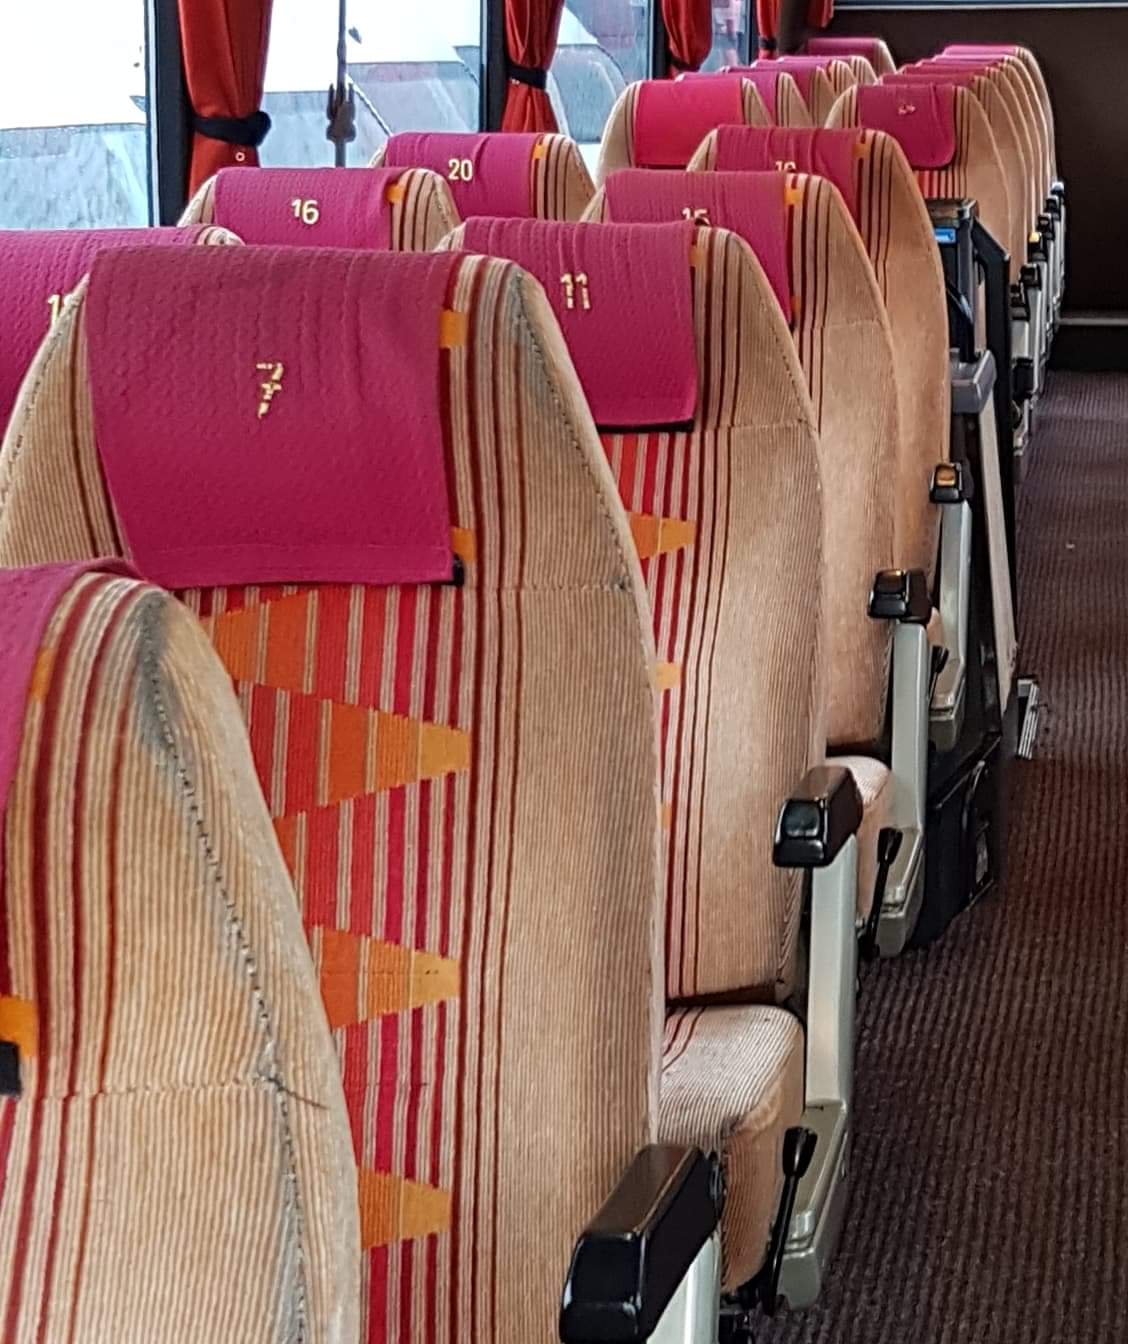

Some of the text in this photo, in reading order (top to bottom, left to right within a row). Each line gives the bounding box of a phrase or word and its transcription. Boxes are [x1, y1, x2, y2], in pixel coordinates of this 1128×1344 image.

[448, 159, 473, 182] 20
[291, 198, 320, 225] 16
[560, 272, 591, 310] 11
[256, 362, 284, 420] 7
